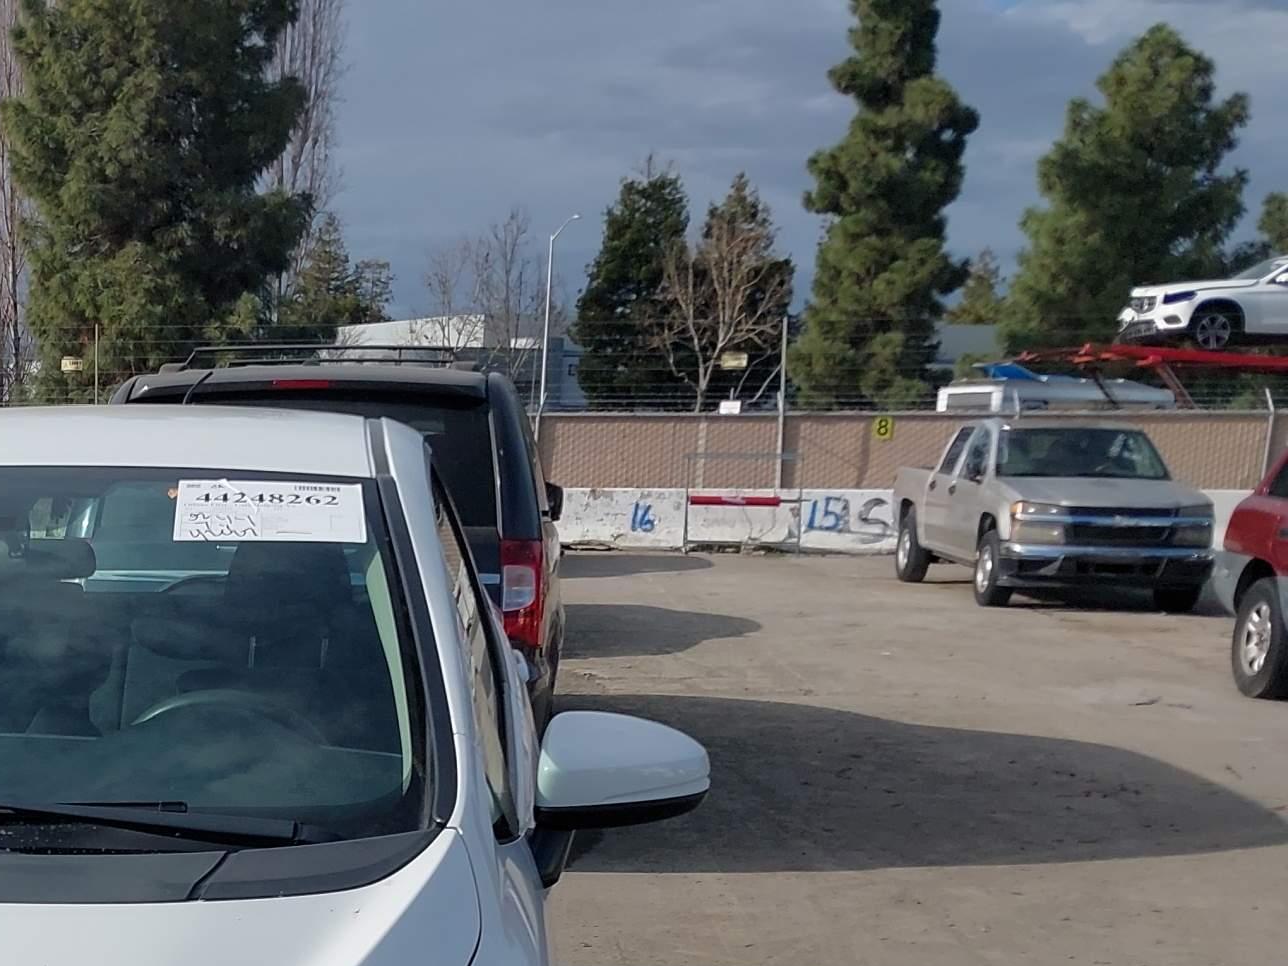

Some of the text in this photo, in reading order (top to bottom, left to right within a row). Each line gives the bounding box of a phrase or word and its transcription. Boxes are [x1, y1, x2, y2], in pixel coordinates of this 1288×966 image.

[877, 419, 889, 436] 8
[195, 492, 339, 505] 44248262
[631, 501, 656, 532] 16
[807, 496, 841, 530] 15
